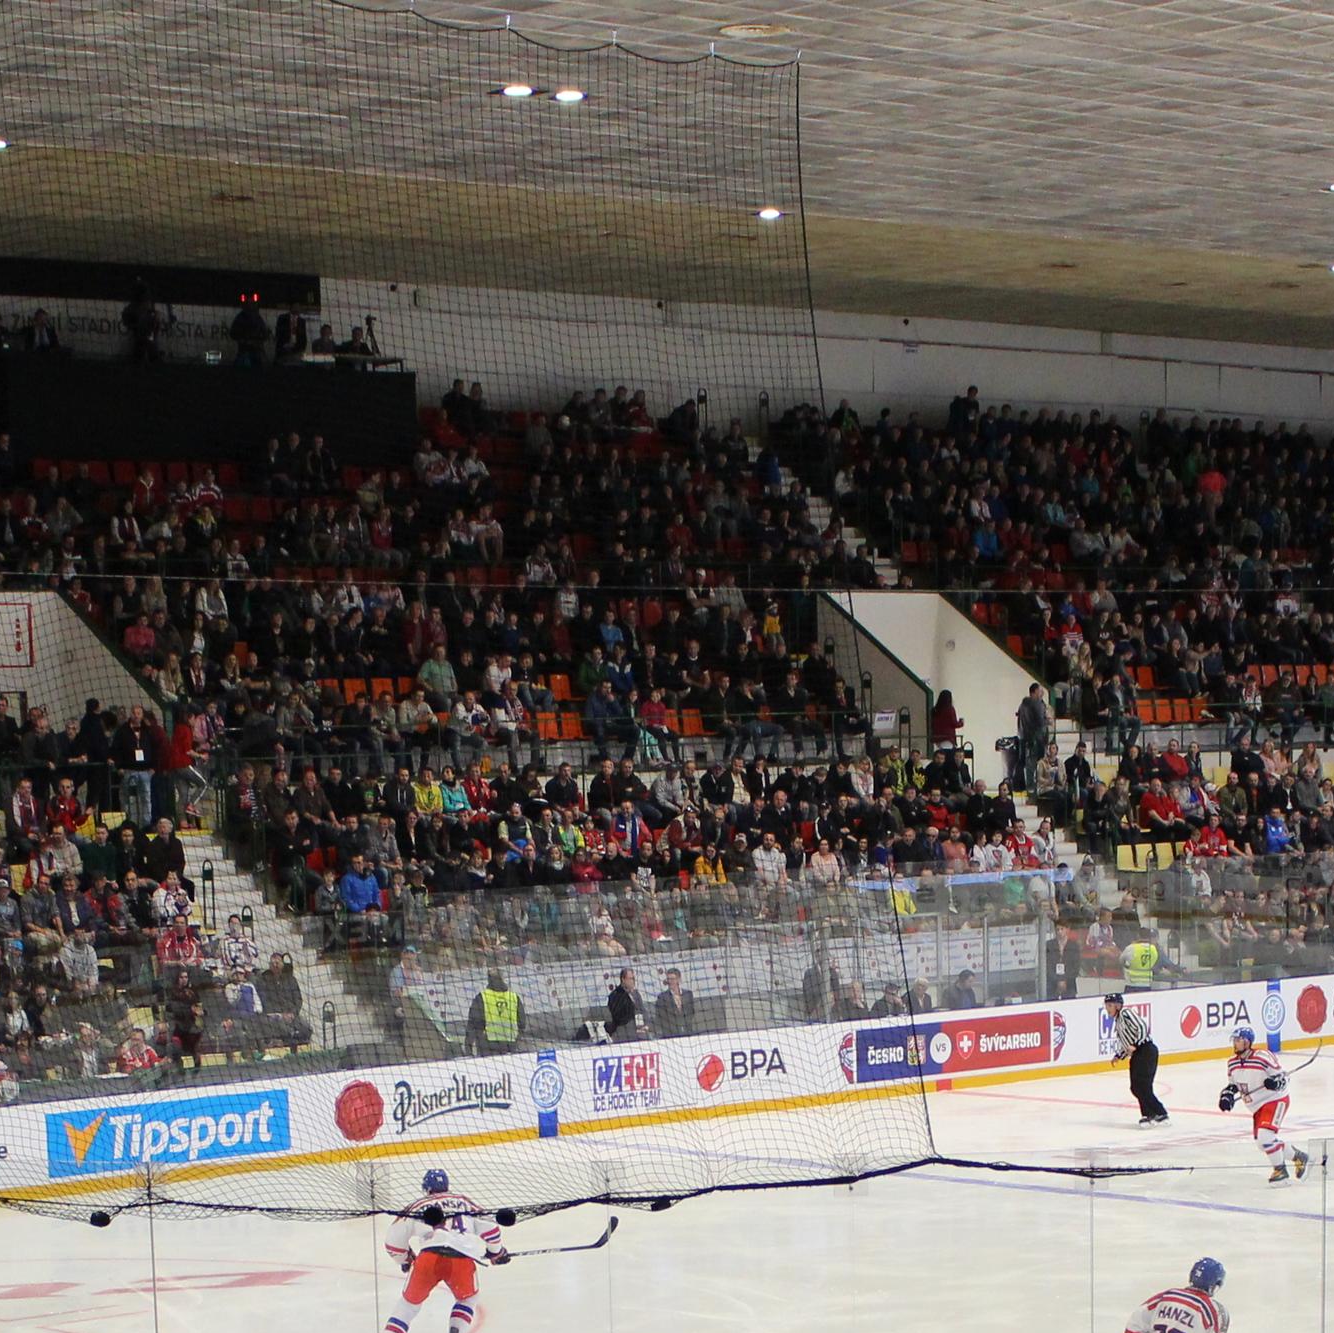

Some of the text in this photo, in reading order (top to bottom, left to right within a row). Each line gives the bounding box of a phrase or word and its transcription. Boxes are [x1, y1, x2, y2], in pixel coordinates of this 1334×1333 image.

[1206, 999, 1250, 1028] BPA
[730, 1047, 787, 1080] BPA
[867, 1044, 905, 1065] ČESKO
[979, 1028, 1042, 1054] ŠVÝCARSKO
[593, 1053, 661, 1095] CZECH
[393, 1080, 455, 1134] Pilsner
[453, 1072, 512, 1110] Urquell
[593, 1091, 661, 1113] ICE HOCKEY TEAM
[109, 1101, 274, 1161] Tipsport
[1158, 1305, 1195, 1329] HANZL
